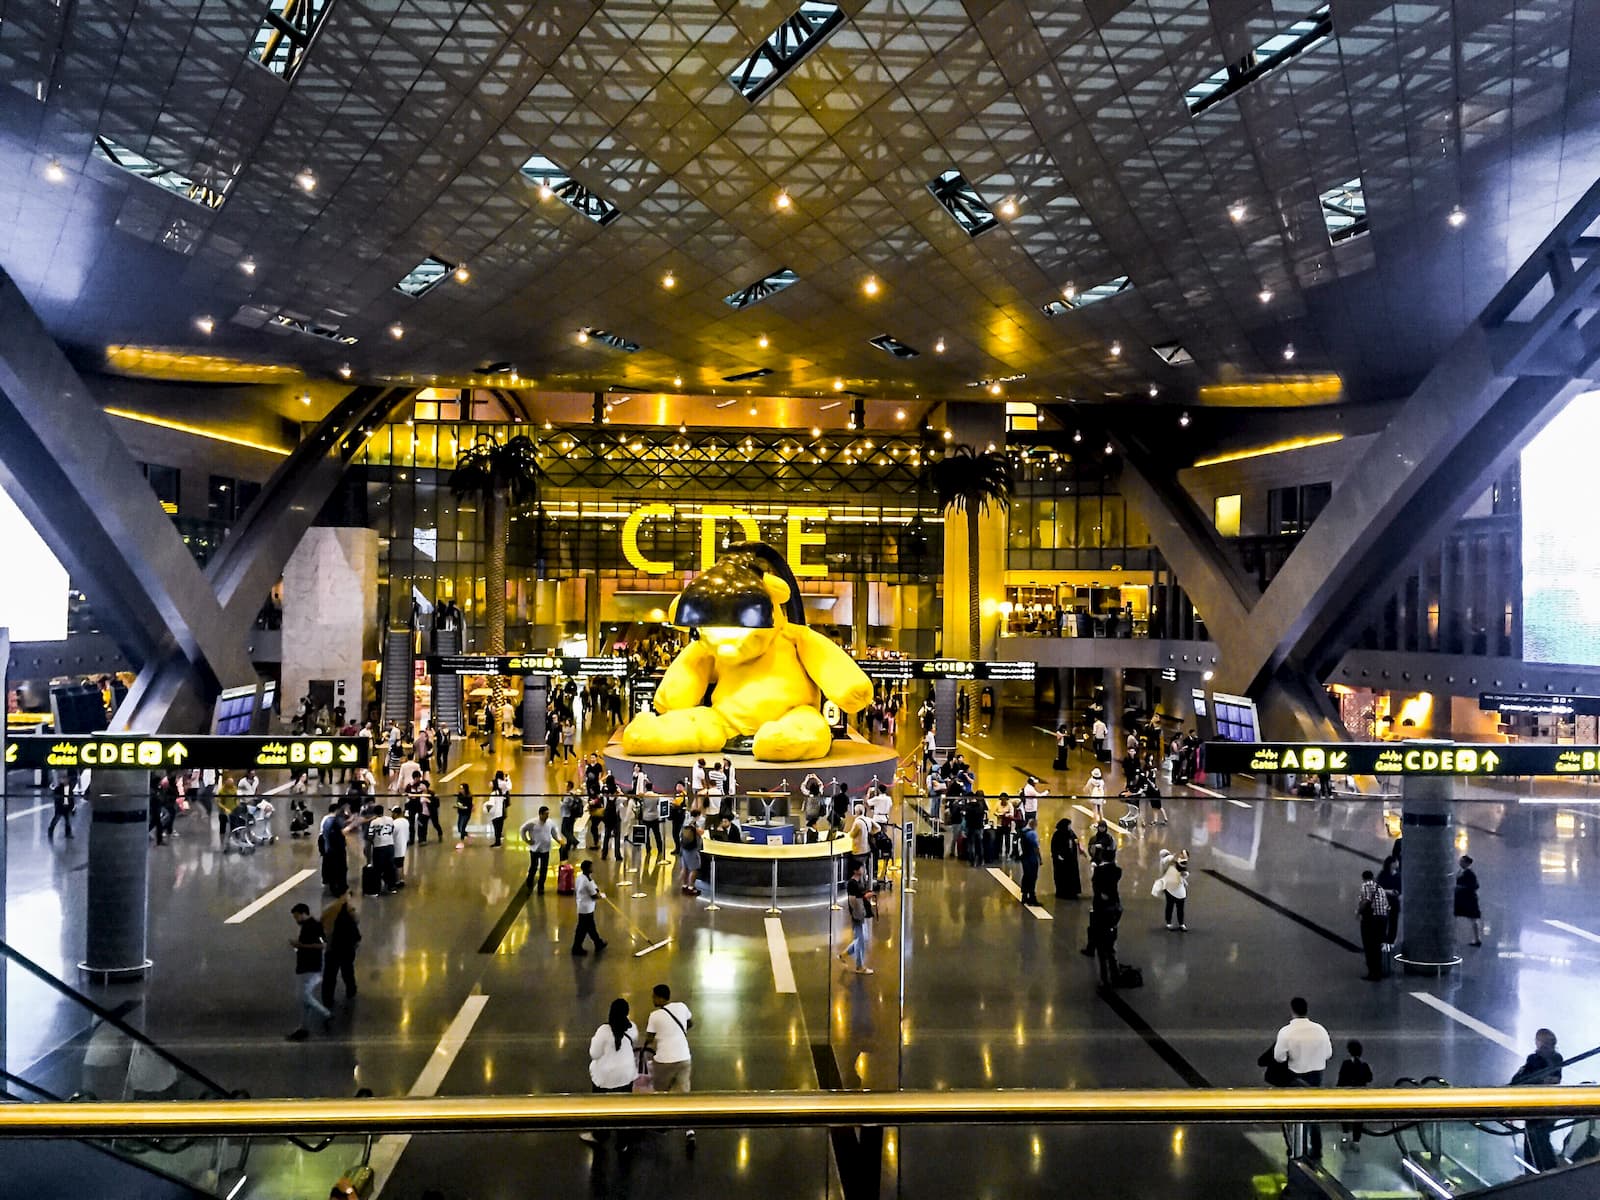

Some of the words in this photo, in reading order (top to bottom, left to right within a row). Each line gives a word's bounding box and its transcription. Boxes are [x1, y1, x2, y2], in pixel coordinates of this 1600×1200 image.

[80, 742, 136, 764] CDE
[290, 742, 306, 763] B
[1281, 749, 1300, 769] A
[1405, 750, 1454, 771] CDE
[1582, 751, 1596, 770] B
[1250, 759, 1279, 770] Gates
[1375, 761, 1403, 771] Gates
